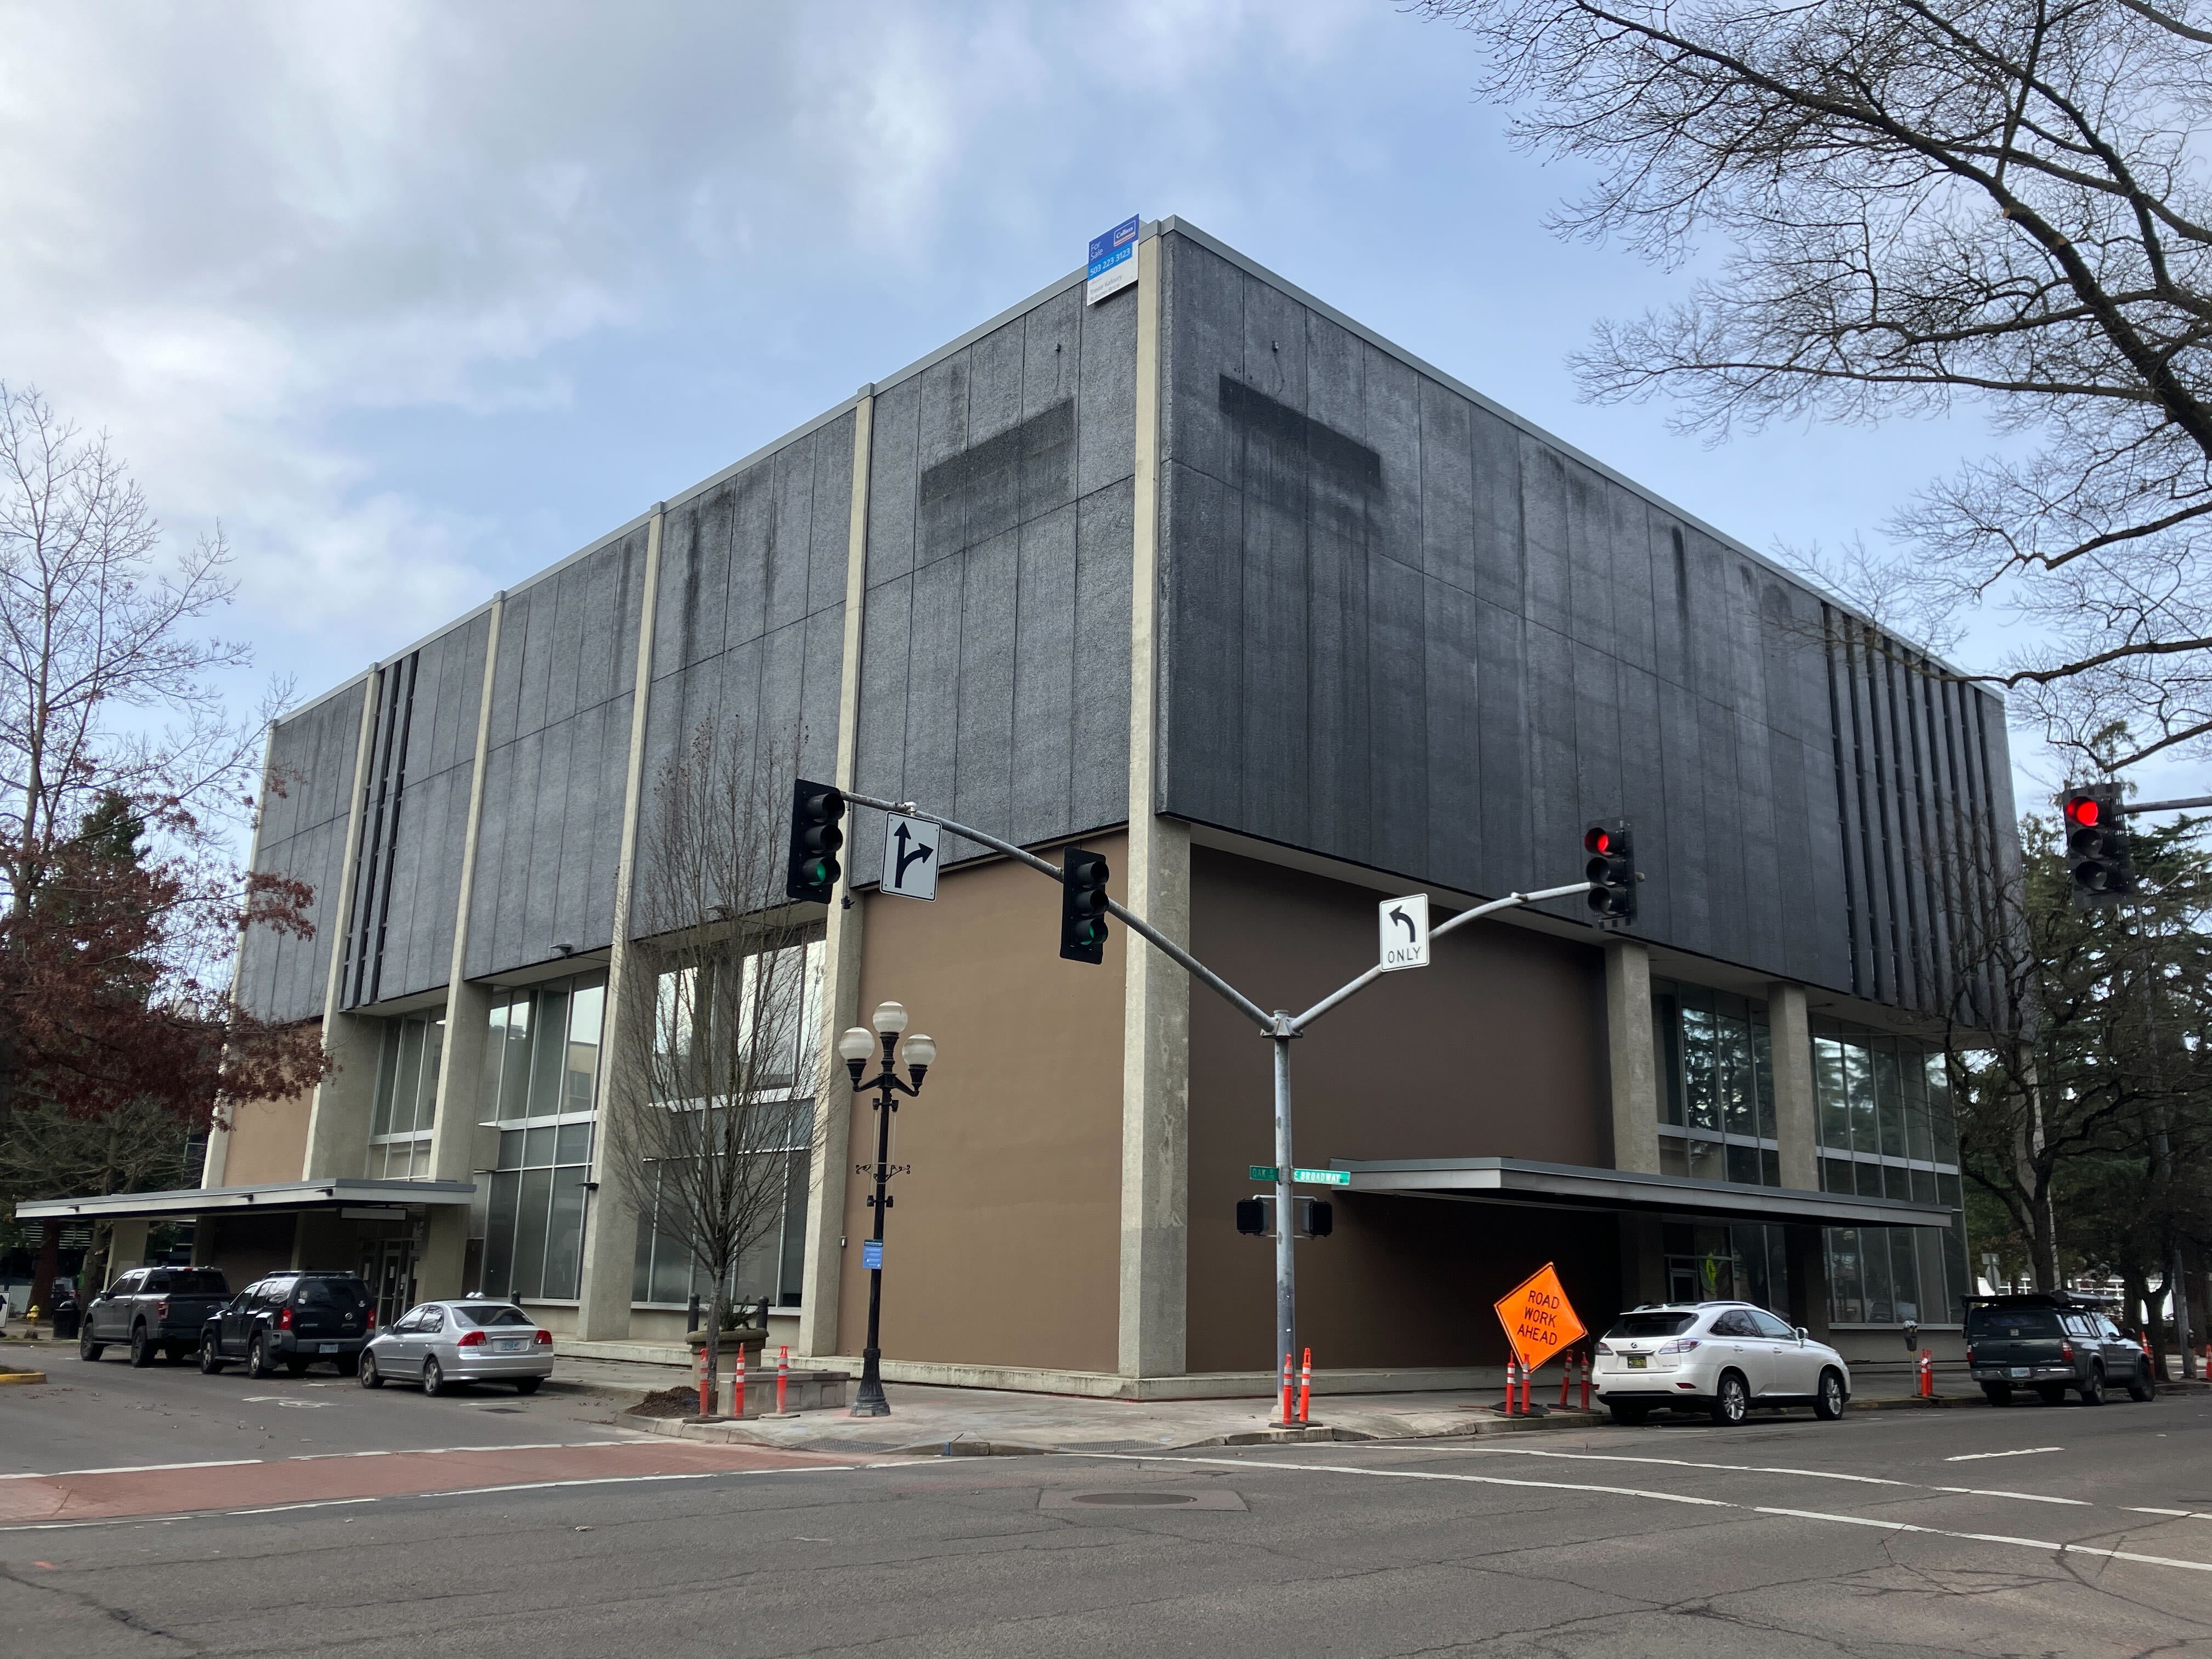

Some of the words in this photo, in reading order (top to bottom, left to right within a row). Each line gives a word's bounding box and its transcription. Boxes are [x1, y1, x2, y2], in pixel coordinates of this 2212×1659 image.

[1116, 227, 1133, 239] Colliers
[1091, 241, 1101, 252] For
[1090, 249, 1103, 261] Sale
[1090, 264, 1102, 276] 503
[1103, 257, 1114, 269] 223
[1115, 247, 1130, 262] 3123
[1387, 946, 1421, 963] ONLY
[1252, 1168, 1266, 1178] OAK
[1300, 1171, 1341, 1182] BROADWAY
[1528, 1290, 1560, 1310] ROAD
[1524, 1306, 1558, 1328] WORK
[1516, 1323, 1558, 1346] AHEAD
